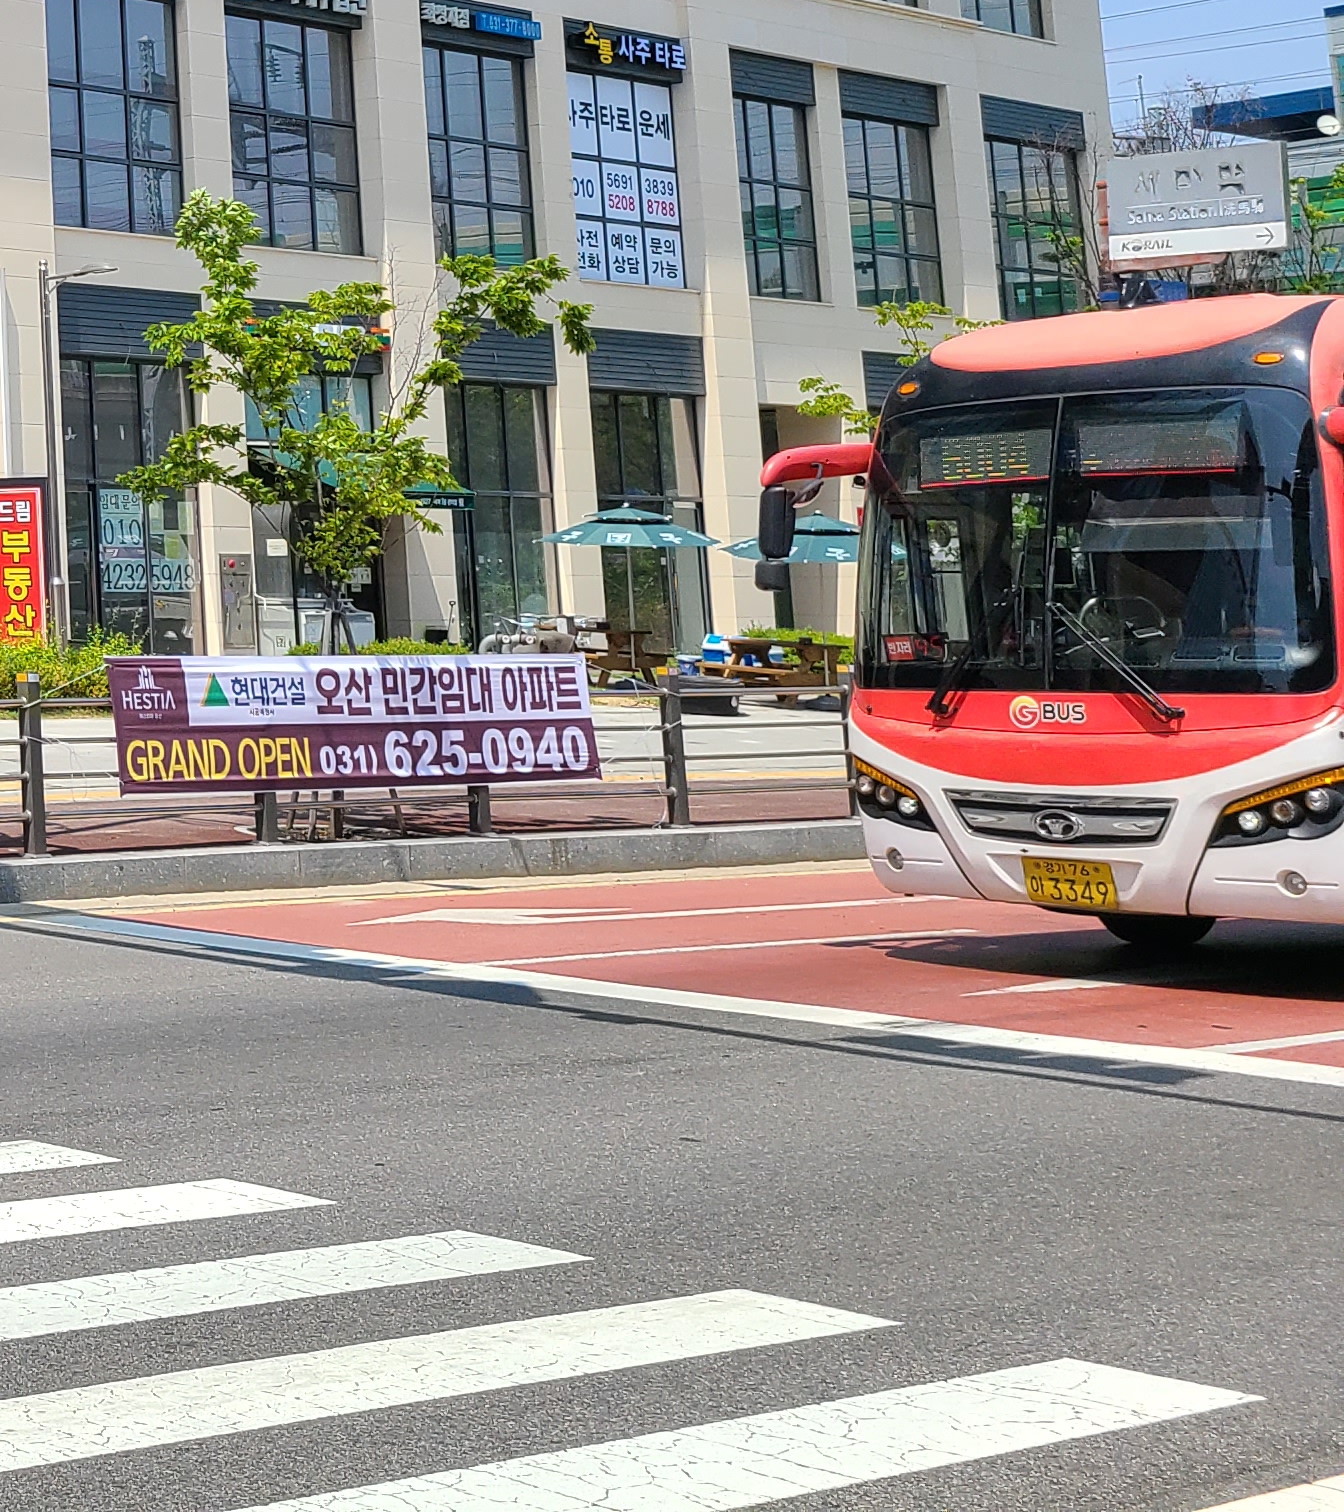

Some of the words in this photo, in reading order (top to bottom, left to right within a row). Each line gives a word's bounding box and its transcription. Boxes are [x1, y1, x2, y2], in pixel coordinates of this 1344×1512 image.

[584, 22, 613, 64] 소통
[619, 35, 651, 65] 사주
[655, 42, 687, 70] 타로
[600, 104, 632, 132] 타로
[639, 109, 670, 140] 운세
[607, 172, 633, 191] 5691
[645, 178, 673, 196] 3839
[608, 193, 636, 212] 5208
[611, 233, 638, 252] 예약
[650, 237, 676, 257] 문의
[613, 255, 640, 275] 상담
[652, 260, 678, 279] 가능
[103, 518, 142, 545] 010
[1, 530, 36, 638] 부동산
[122, 690, 176, 710] HESTIA
[231, 676, 306, 707] 현대건설
[315, 667, 372, 716] 오산
[380, 666, 493, 716] 민간임대
[502, 665, 582, 713] 아파트
[126, 739, 231, 782] GRAND
[238, 737, 312, 780] OPEN
[319, 745, 378, 775] 031)
[384, 725, 590, 777] 625-0940
